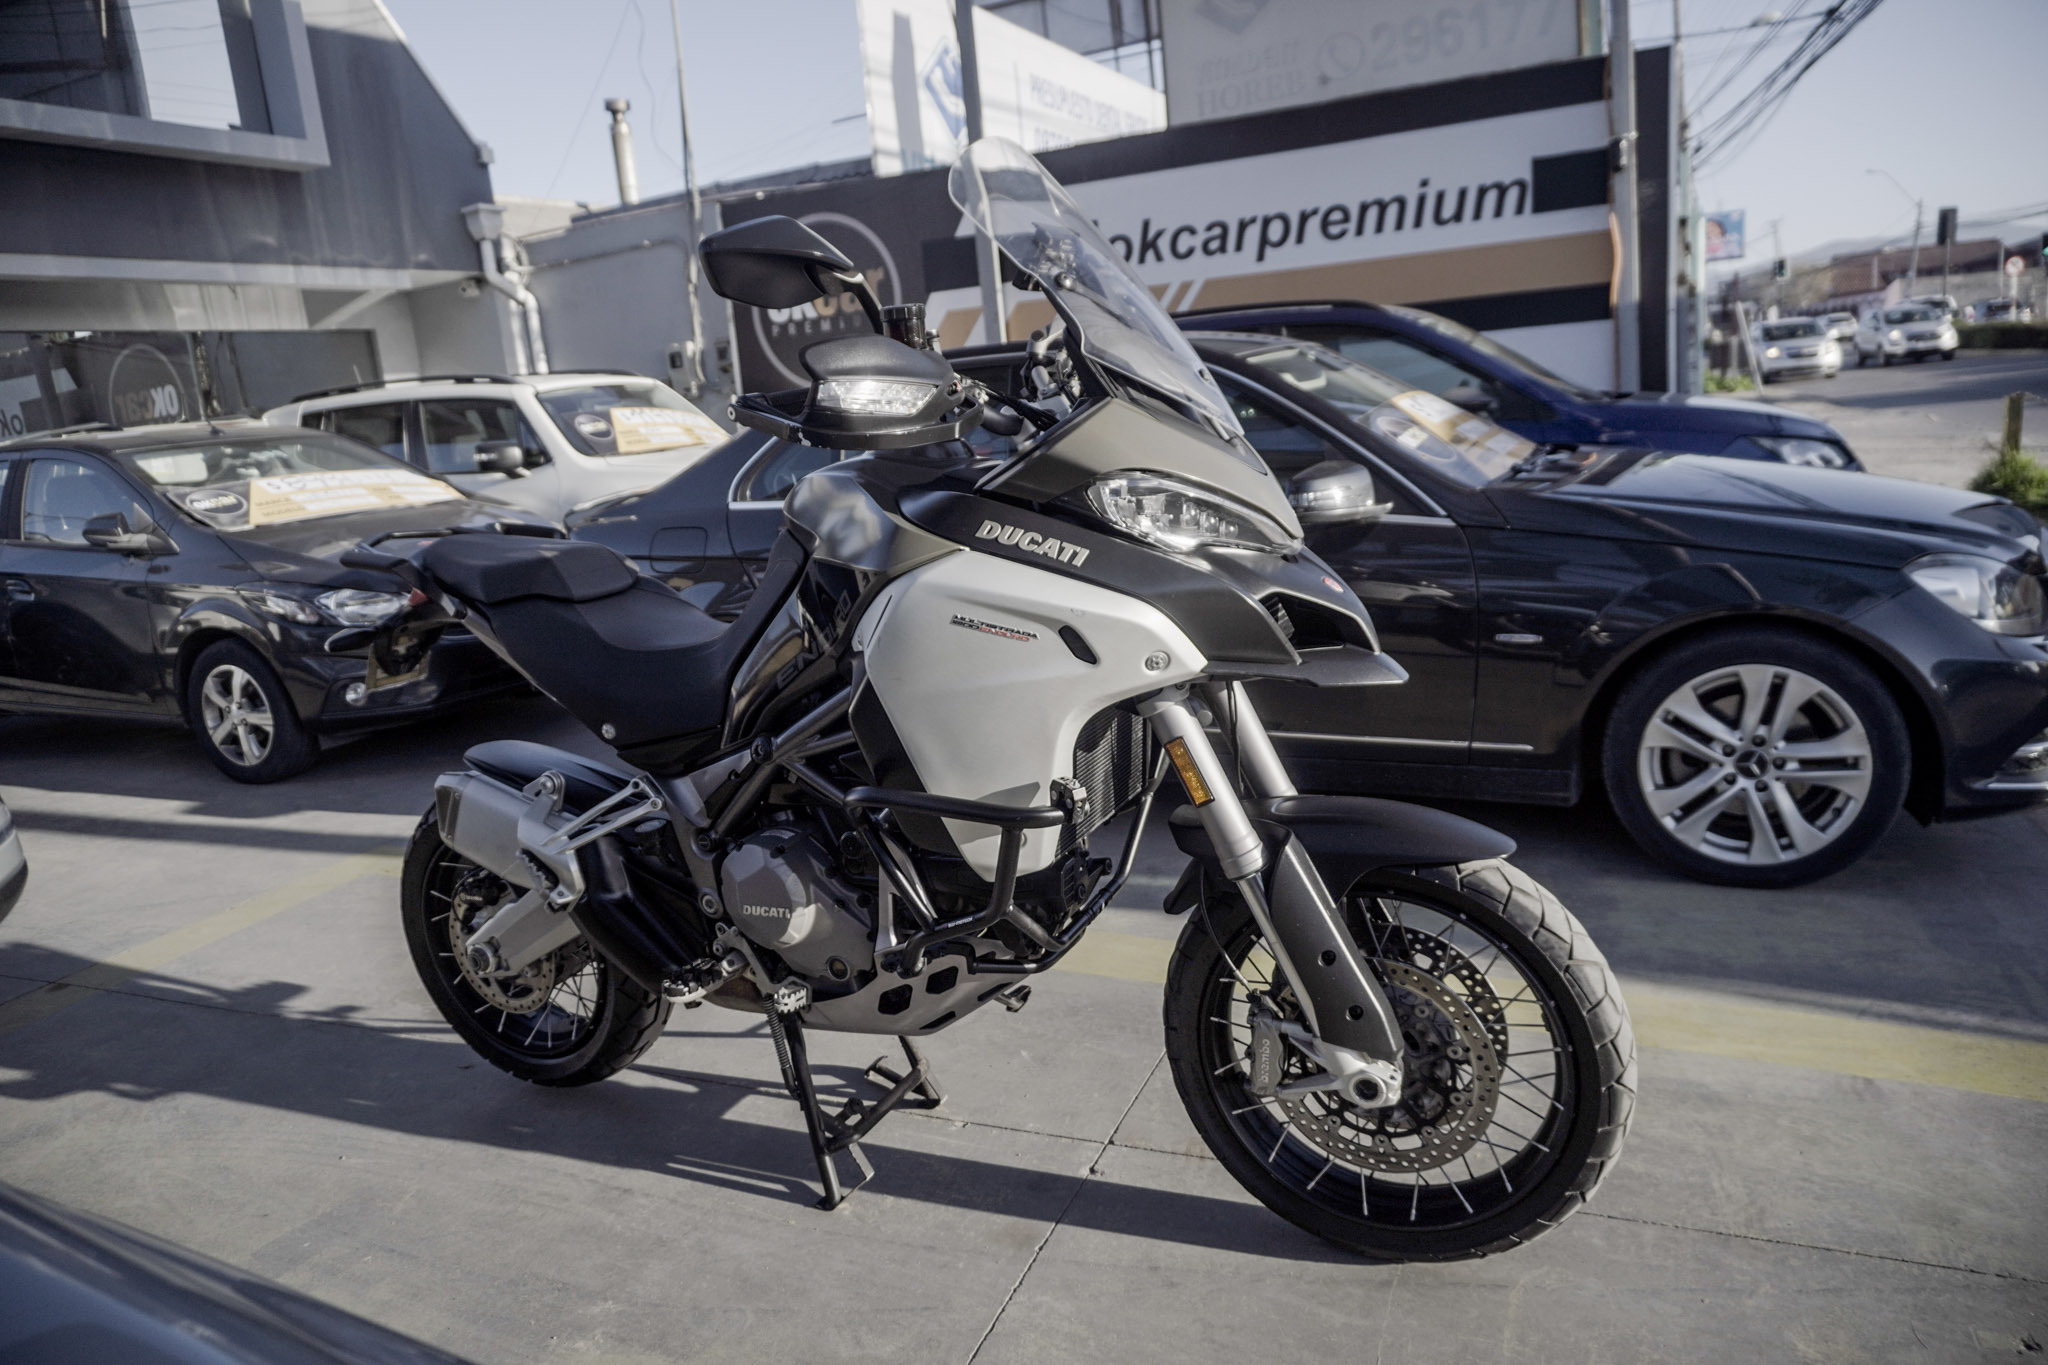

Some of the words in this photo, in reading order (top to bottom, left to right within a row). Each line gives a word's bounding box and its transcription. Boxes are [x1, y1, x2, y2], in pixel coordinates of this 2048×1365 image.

[1092, 176, 1530, 265] okcarpremium
[975, 520, 1090, 567] DUCATI
[743, 904, 791, 920] DUCATI
[1259, 1038, 1270, 1083] brembo
